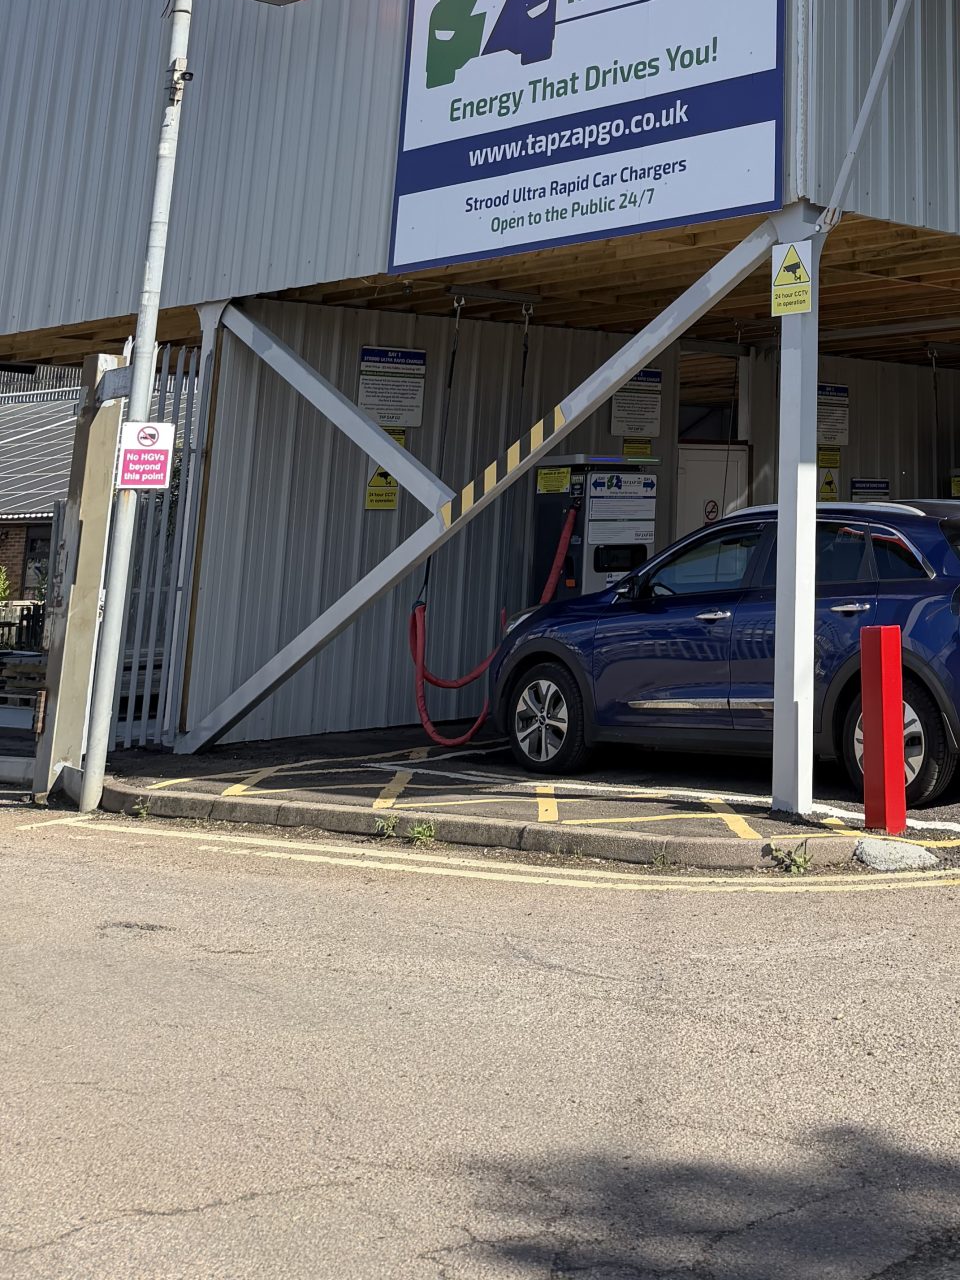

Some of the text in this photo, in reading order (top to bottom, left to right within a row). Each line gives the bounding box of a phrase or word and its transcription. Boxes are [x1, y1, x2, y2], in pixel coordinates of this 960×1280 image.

[449, 36, 719, 122] Energy That Drives You!
[469, 101, 689, 167] www.tapzapgo.co.uk
[465, 158, 687, 213] Strood Ultra Rapid Car Chargers
[490, 188, 655, 235] Open to the Public 24/7
[794, 289, 808, 297] CCTV
[782, 299, 806, 307] operation
[127, 453, 165, 461] No HGVs
[129, 463, 161, 472] beyond
[124, 472, 164, 481] this point
